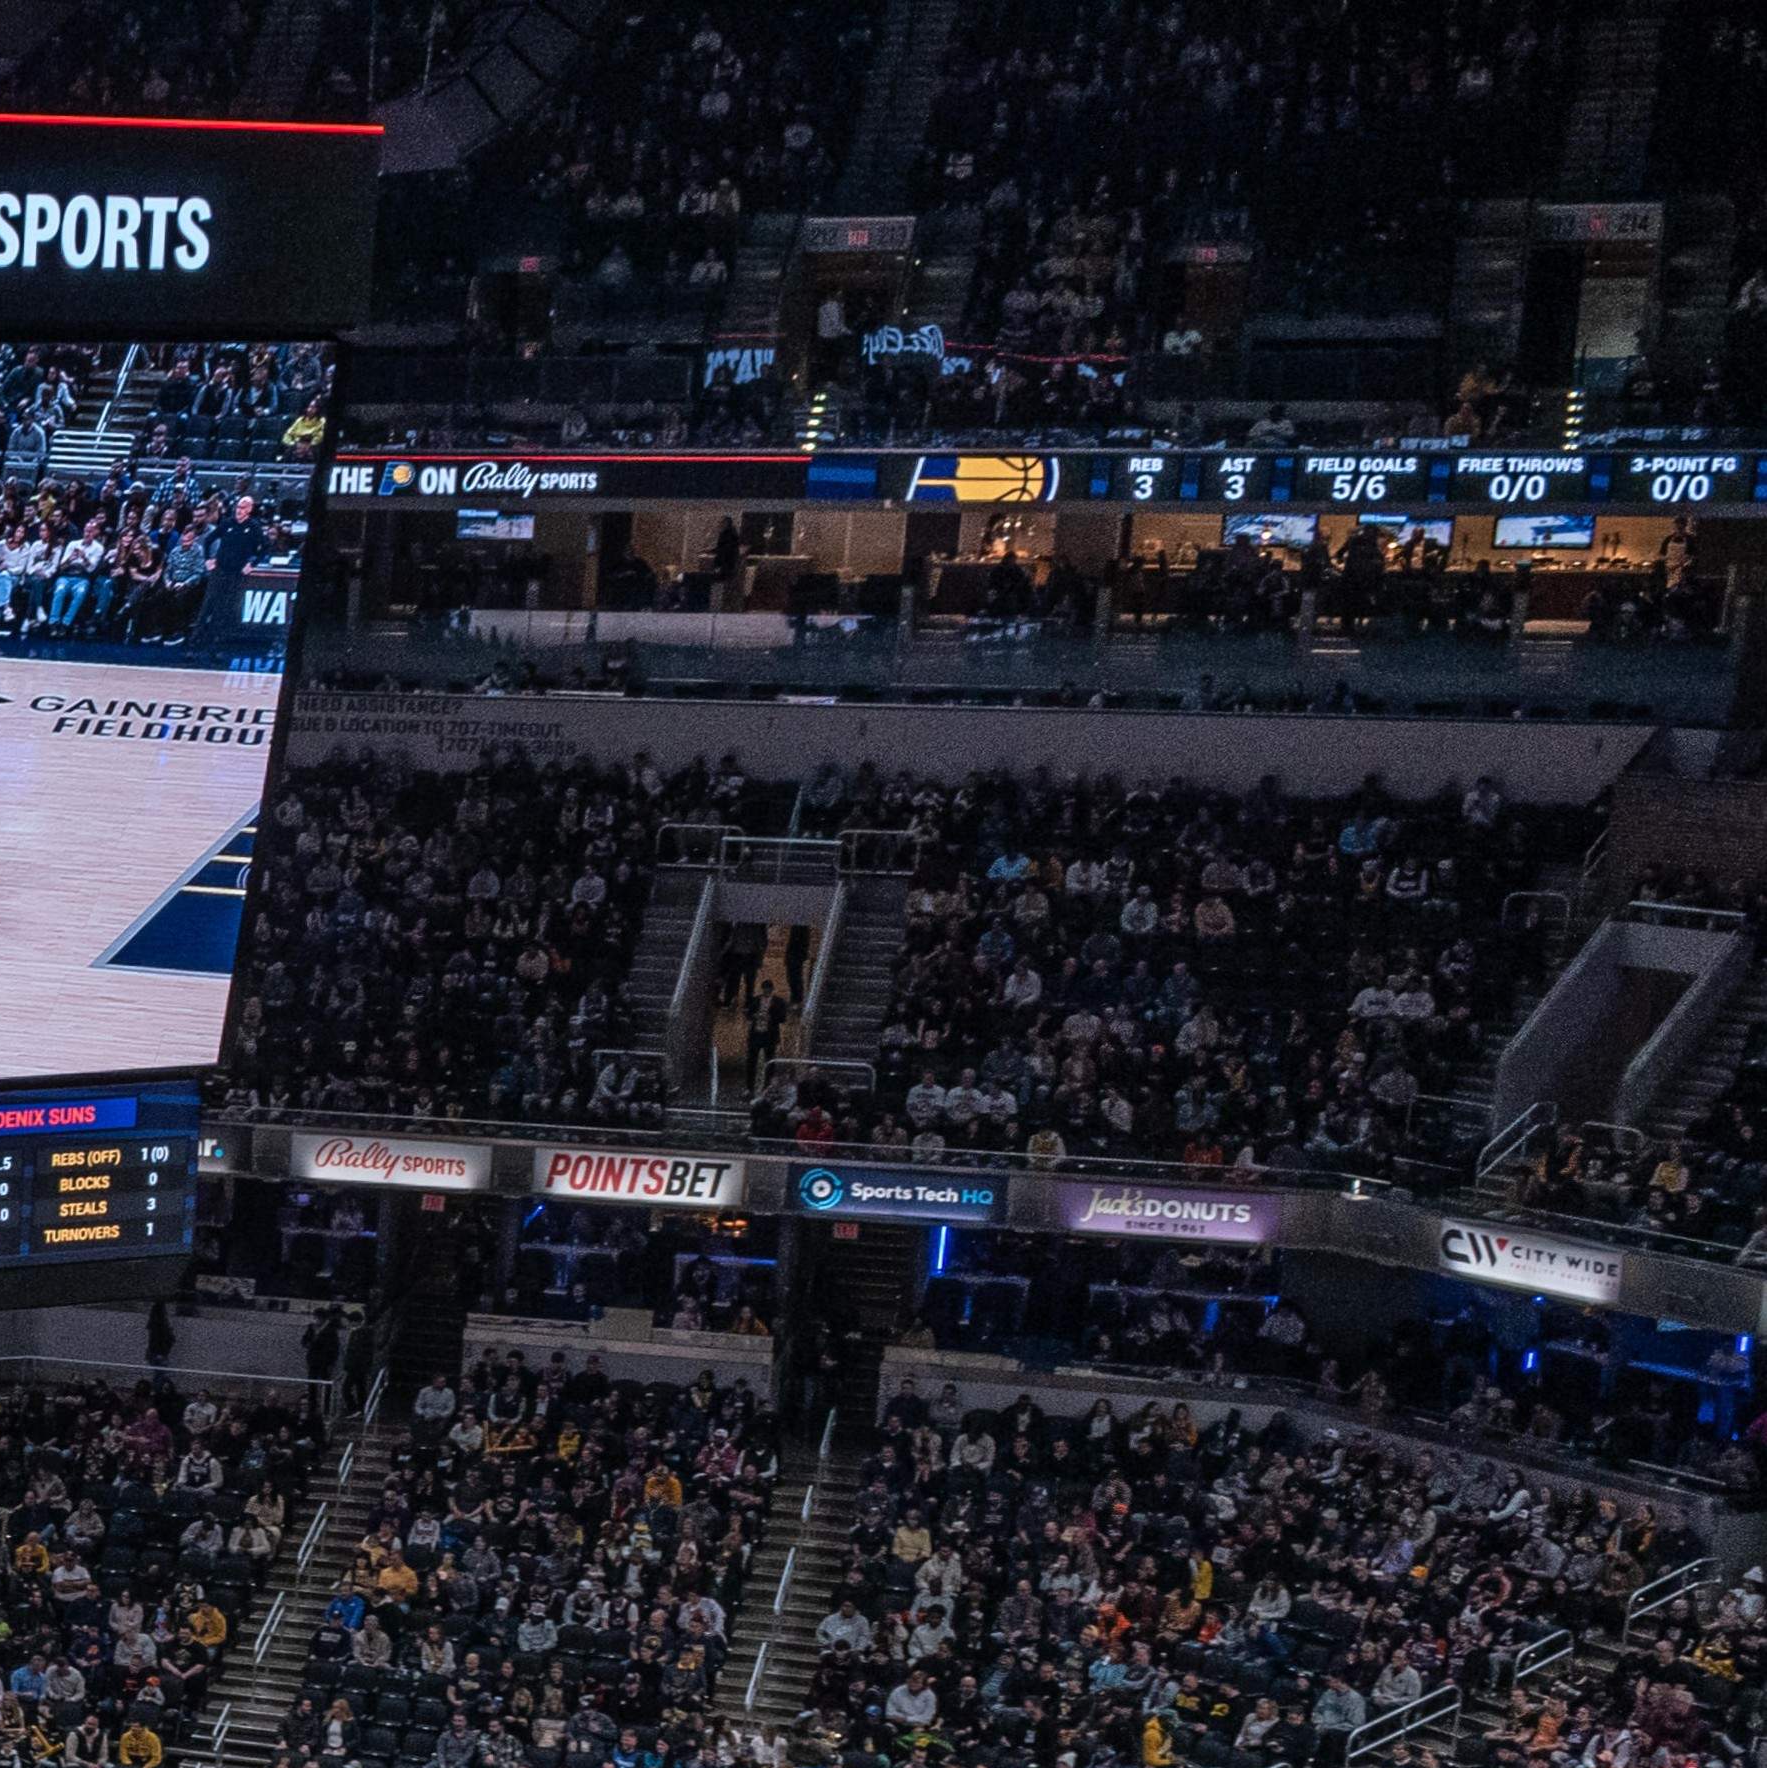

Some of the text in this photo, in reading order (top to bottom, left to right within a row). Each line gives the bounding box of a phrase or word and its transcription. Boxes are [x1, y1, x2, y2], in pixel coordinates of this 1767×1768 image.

[1130, 458, 1736, 473] REB AST FIELD GOALS FREE THROWS 3-POINT FG
[419, 462, 597, 498] ON Bally SPORTS
[1135, 476, 1708, 501] 3 3 5/6 0/0 0/0
[49, 1106, 95, 1124] SUNS
[314, 1139, 465, 1180] Bally SPORTS
[546, 1152, 731, 1198] POINTSBET
[850, 1180, 993, 1206] Sports Tech HQ
[1146, 1199, 1251, 1223] DONUTS
[1511, 1244, 1557, 1264] CITY
[1566, 1256, 1619, 1278] WIDE
